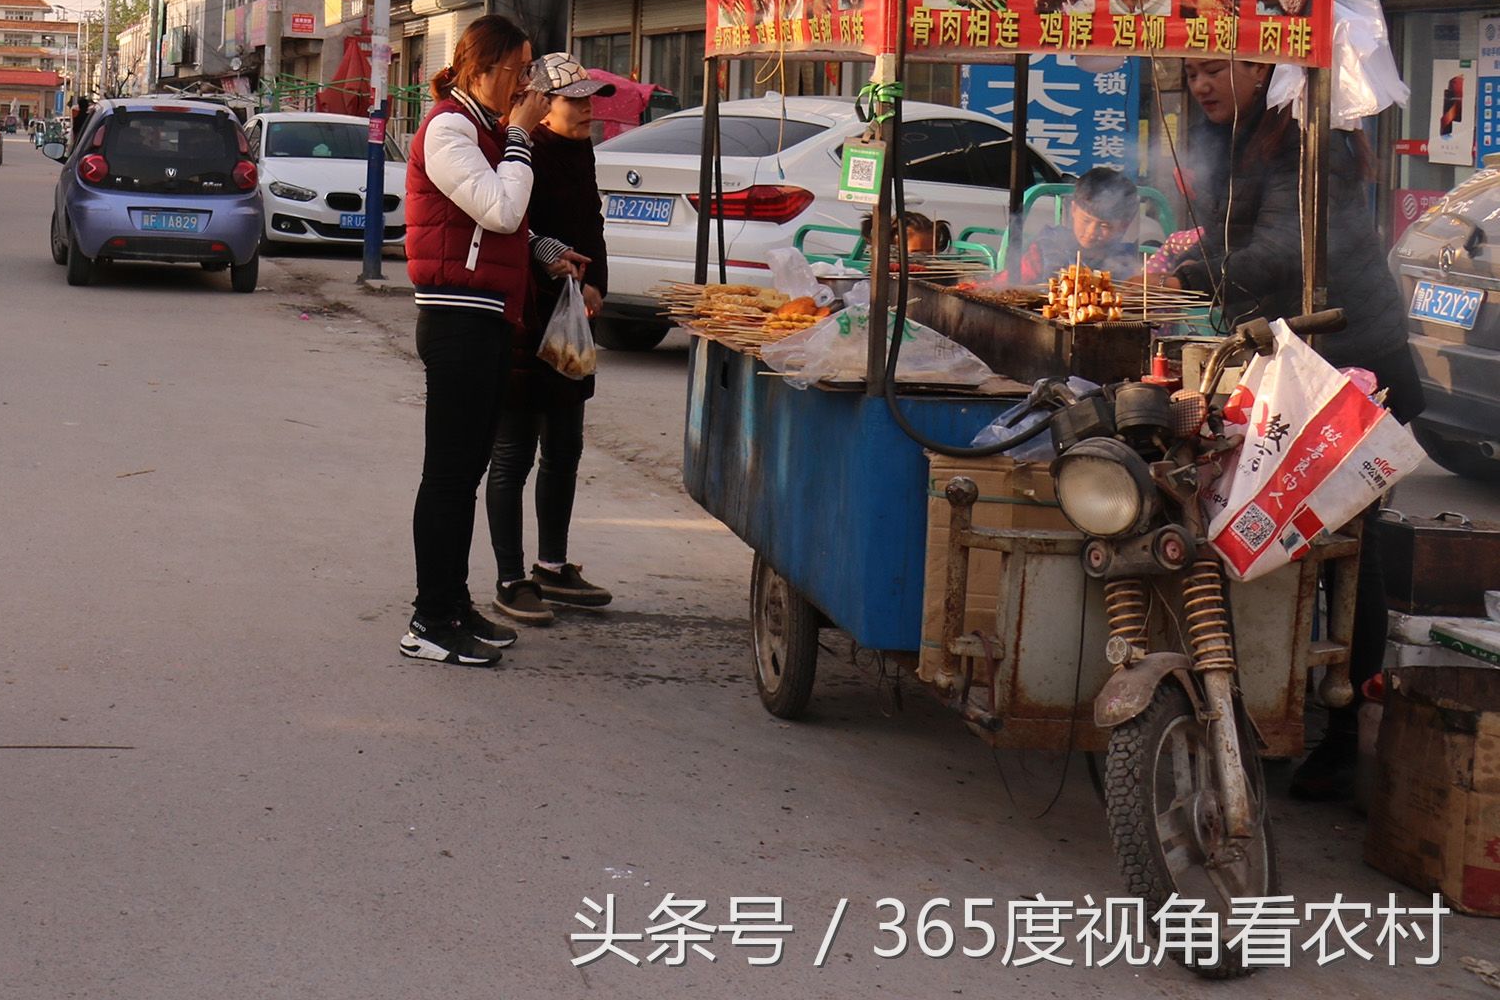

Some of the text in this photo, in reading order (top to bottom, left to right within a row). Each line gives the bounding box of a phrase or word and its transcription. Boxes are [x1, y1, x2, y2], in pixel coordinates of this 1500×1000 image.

[910, 6, 1312, 57] 骨肉相连 鸡脖 鸡柳 鸡翅 肉排
[985, 54, 1083, 178] 大卖
[1267, 423, 1344, 510] 做善良的人
